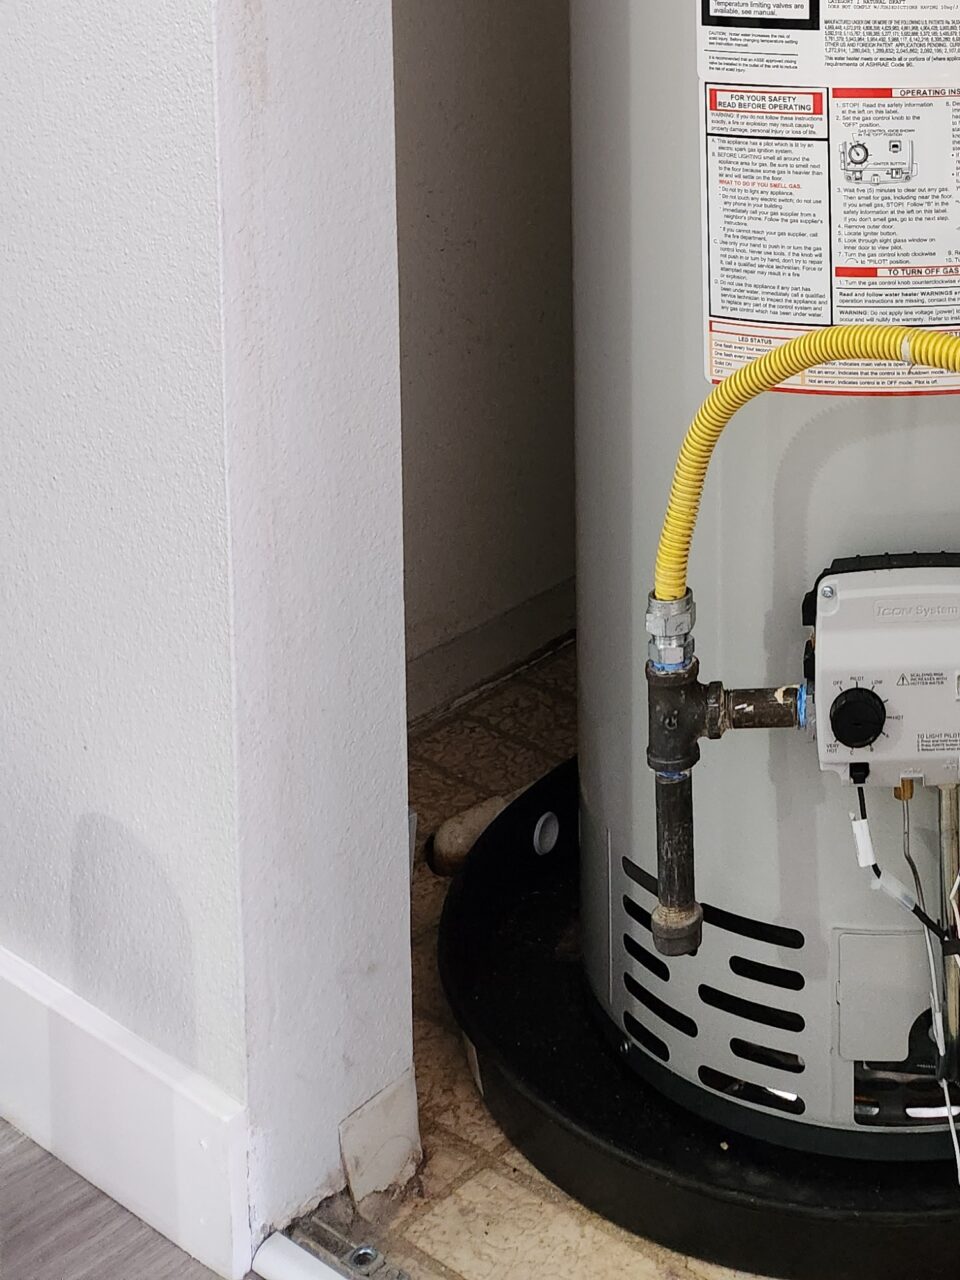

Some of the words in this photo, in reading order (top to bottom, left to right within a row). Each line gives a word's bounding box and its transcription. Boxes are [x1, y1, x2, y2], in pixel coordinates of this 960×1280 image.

[714, 0, 748, 9] Temperature
[749, 1, 771, 9] limiting
[899, 88, 945, 96] OPERATING
[888, 268, 898, 276] TO
[901, 267, 922, 276] TURN
[924, 267, 939, 275] OFF
[942, 266, 958, 274] GAS
[738, 336, 748, 344] LED
